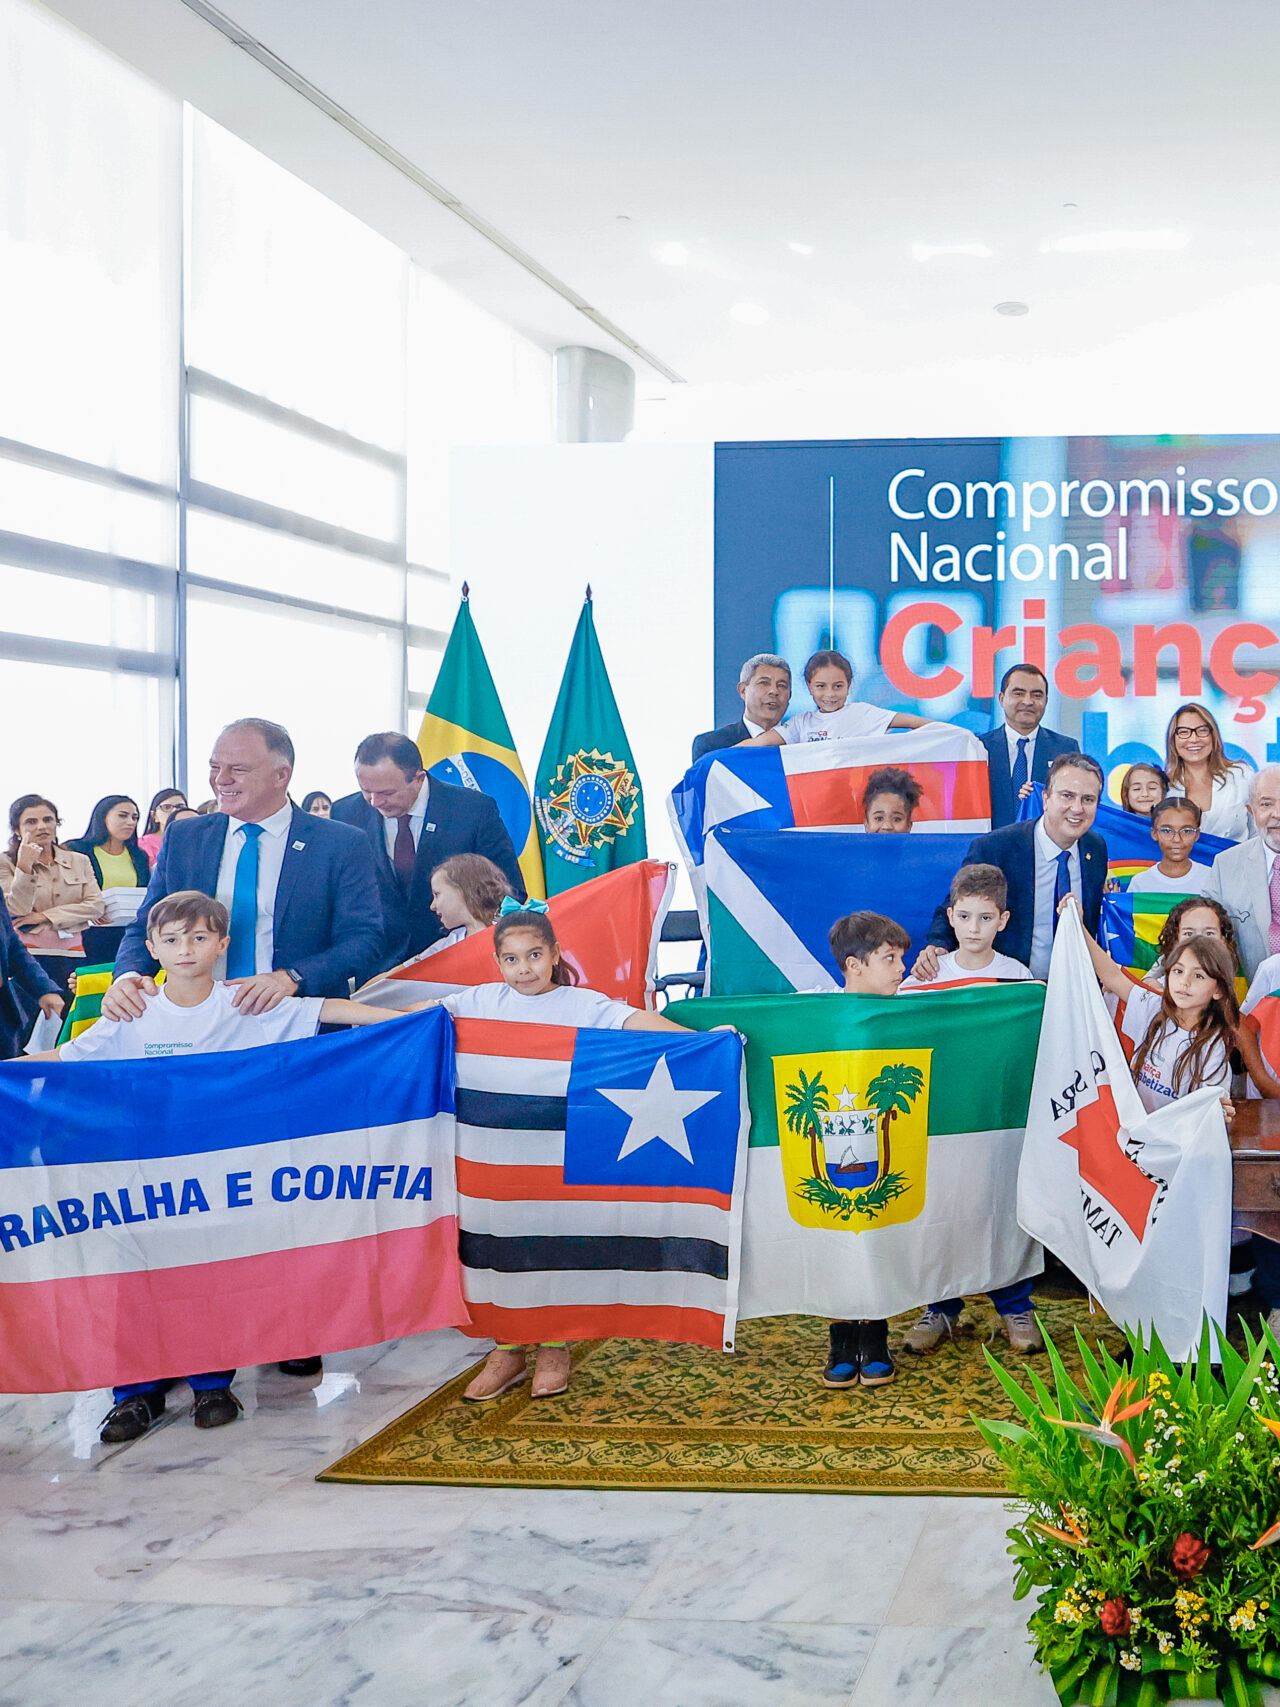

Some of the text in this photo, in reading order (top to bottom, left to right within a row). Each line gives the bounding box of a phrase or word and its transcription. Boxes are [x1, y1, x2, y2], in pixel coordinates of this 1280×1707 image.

[887, 465, 1278, 532] Compromisso
[889, 527, 1128, 583] Nacional
[144, 1042, 193, 1050] Compromisso
[0, 1164, 433, 1253] RABALHA E CONFIA
